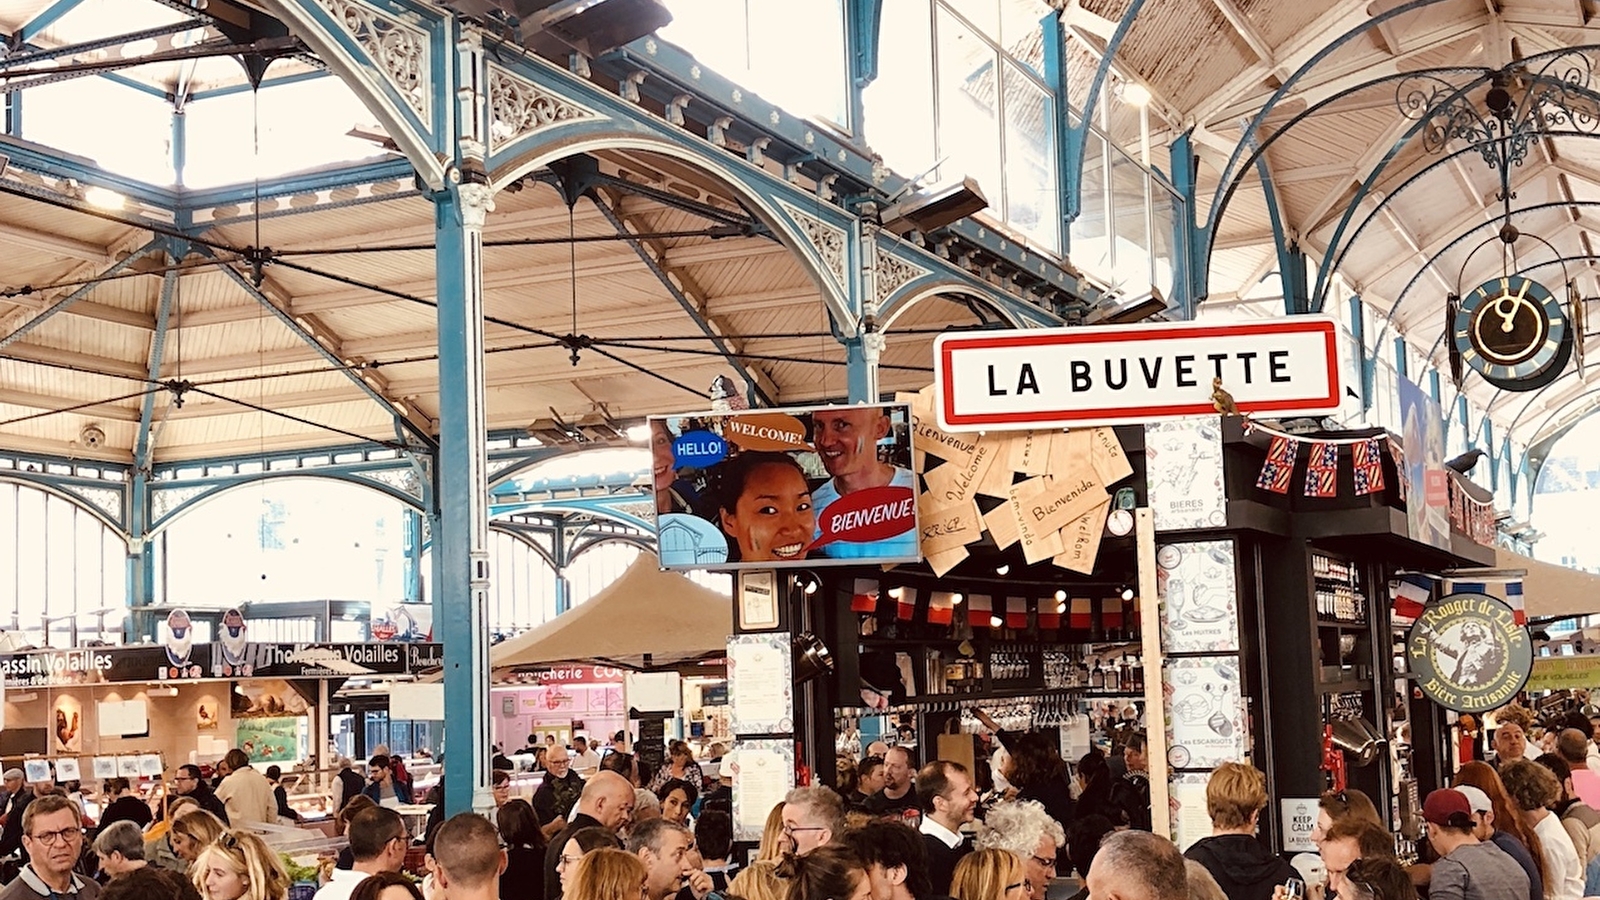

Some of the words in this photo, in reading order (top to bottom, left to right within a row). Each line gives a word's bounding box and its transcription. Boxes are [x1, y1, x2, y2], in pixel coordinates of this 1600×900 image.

[987, 362, 1040, 396] LA
[1069, 350, 1291, 392] BUVETTE
[676, 441, 723, 456] HELLO!
[730, 421, 803, 445] WELCOME!
[912, 415, 976, 455] Bienvenue
[945, 446, 988, 502] Welcome
[830, 498, 915, 534] BIENVENUE!
[1009, 488, 1035, 546] bem-vindo
[1032, 478, 1096, 522] Bienvenida
[1170, 499, 1204, 509] BIERES
[1410, 637, 1428, 659] La
[1423, 598, 1476, 627] Rouget
[1478, 600, 1495, 616] de
[1494, 609, 1524, 644] Lisle
[44, 650, 113, 671] Volailles
[344, 644, 399, 663] Volailles
[1424, 678, 1457, 704] Bière
[1461, 670, 1522, 708] Artisanale
[1291, 823, 1314, 832] CALM
[1293, 815, 1312, 824] KEEP
